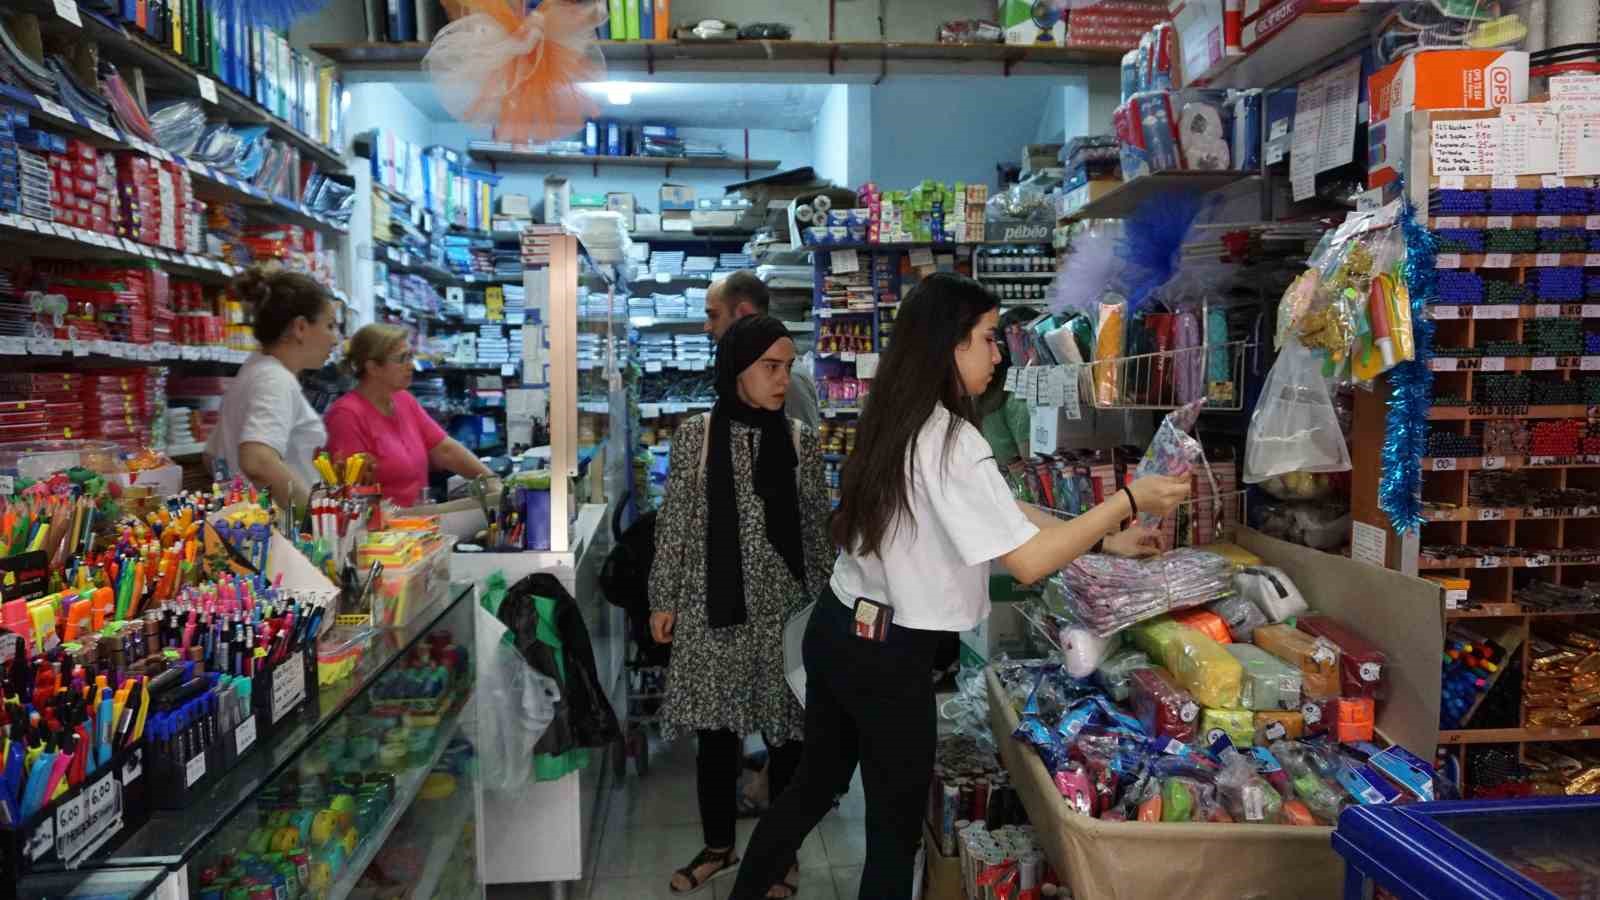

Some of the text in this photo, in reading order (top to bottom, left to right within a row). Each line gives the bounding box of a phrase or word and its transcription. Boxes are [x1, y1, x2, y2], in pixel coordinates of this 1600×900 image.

[1493, 71, 1508, 105] OPS
[91, 780, 111, 805] 6.00
[60, 804, 80, 827] 6.00
